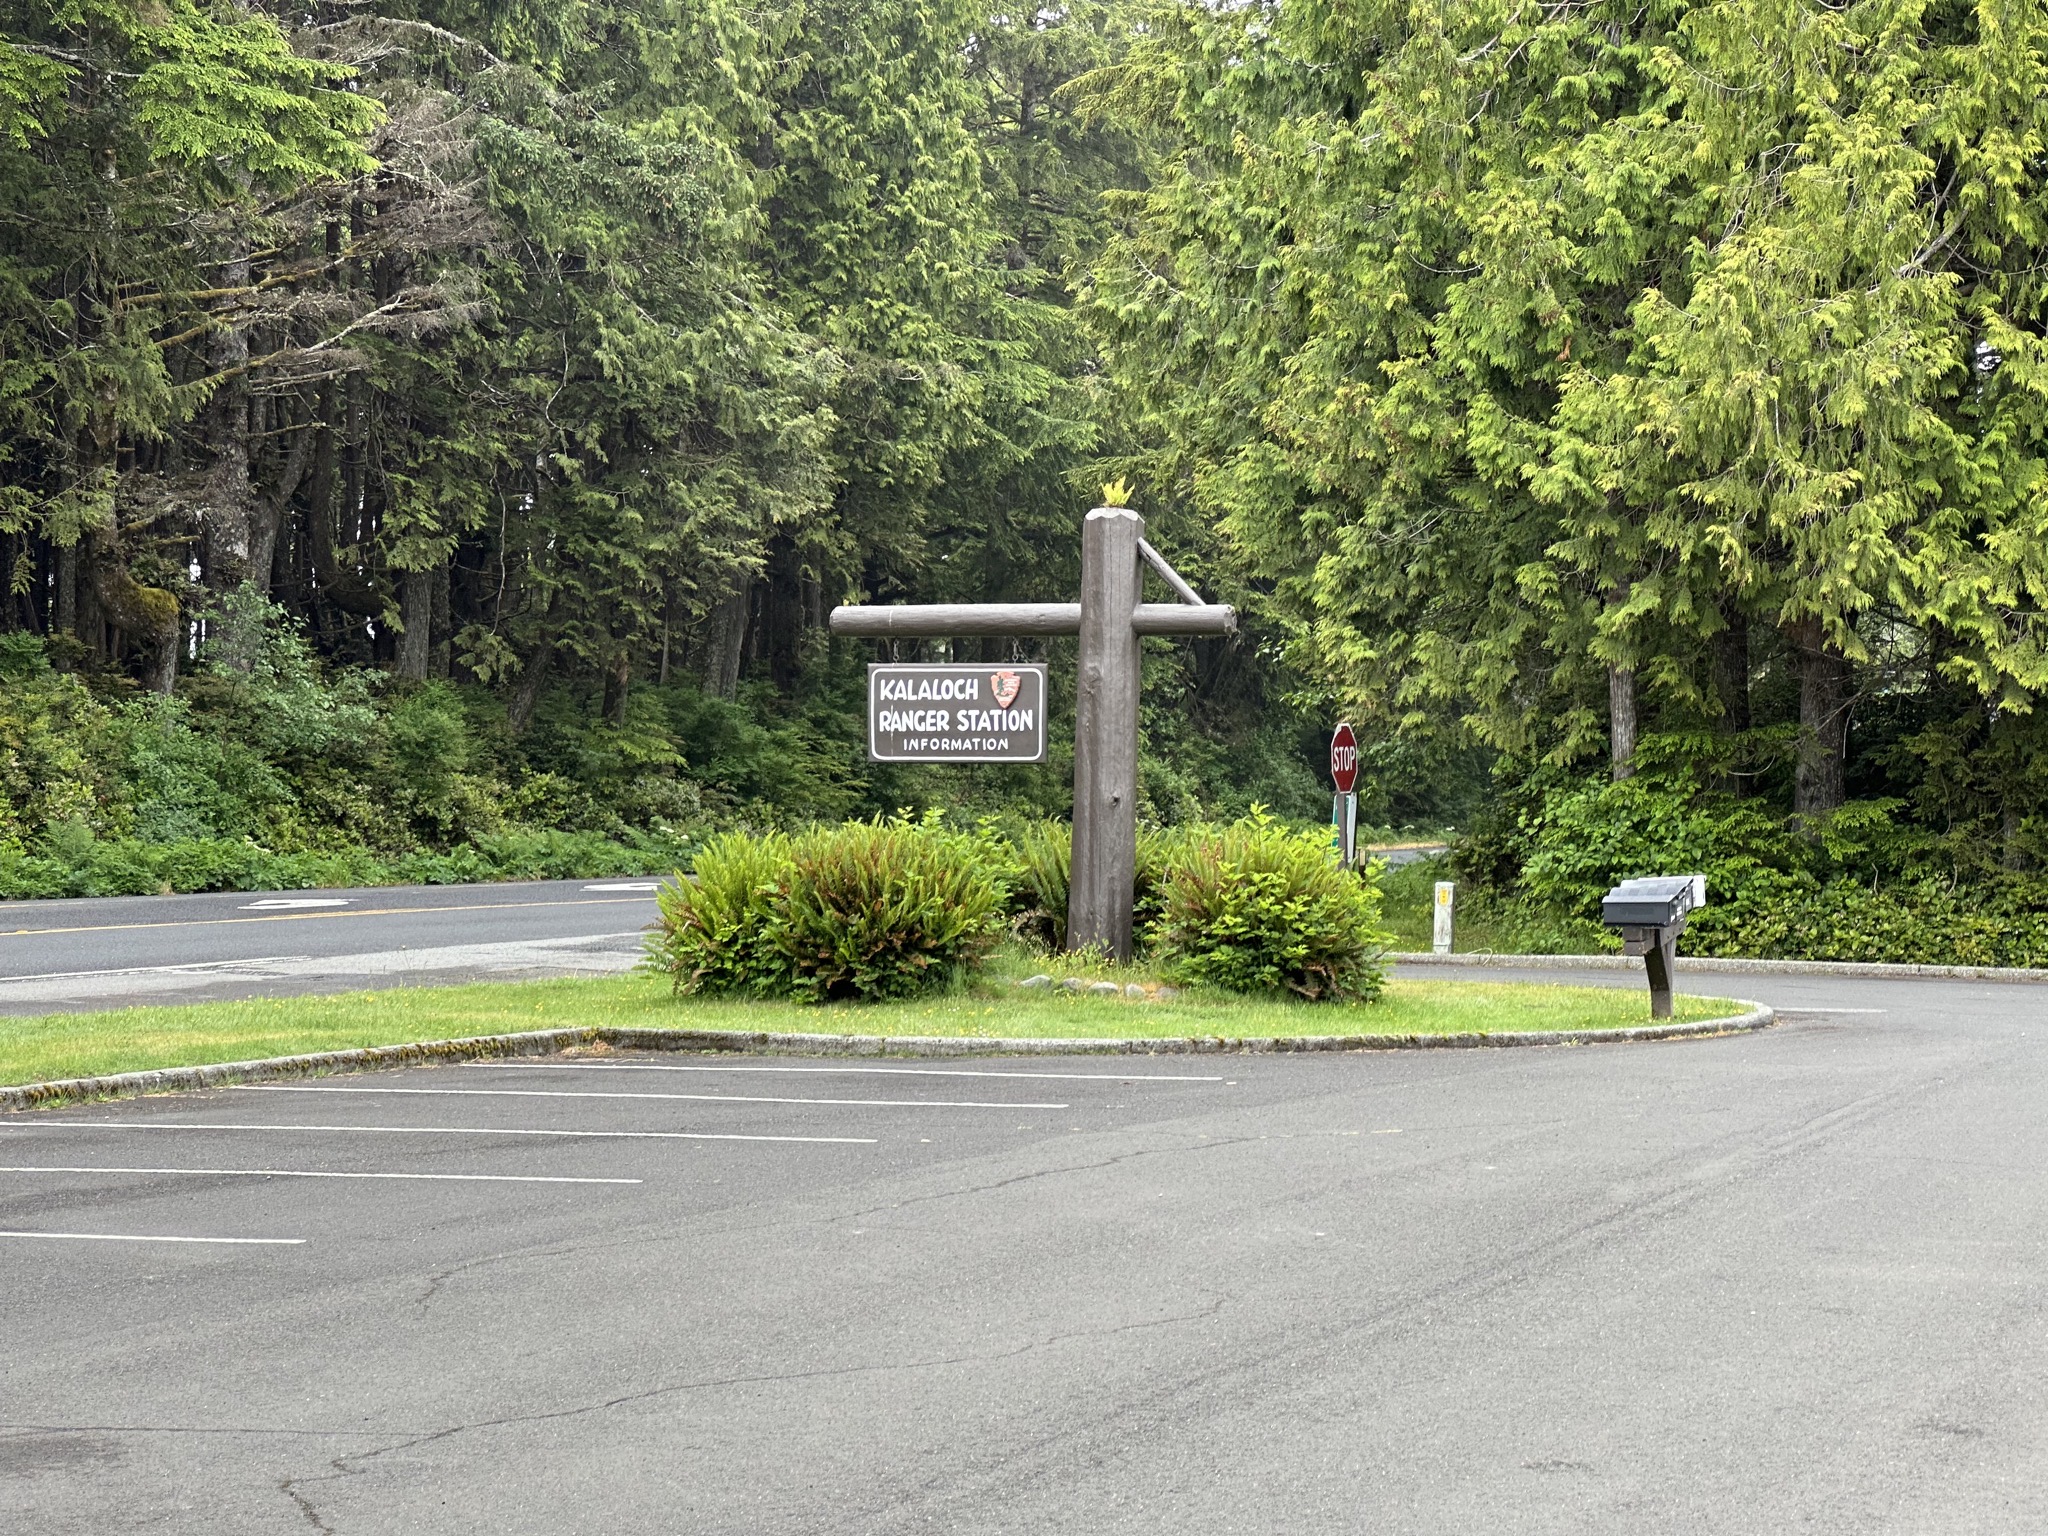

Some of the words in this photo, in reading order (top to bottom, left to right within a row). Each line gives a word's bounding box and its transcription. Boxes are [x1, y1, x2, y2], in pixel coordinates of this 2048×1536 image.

[880, 679, 978, 700] KALALOCH
[879, 710, 949, 731] RANGER
[957, 709, 1033, 731] STATION
[903, 738, 1008, 751] INFORMATION
[1334, 747, 1355, 771] STOP
